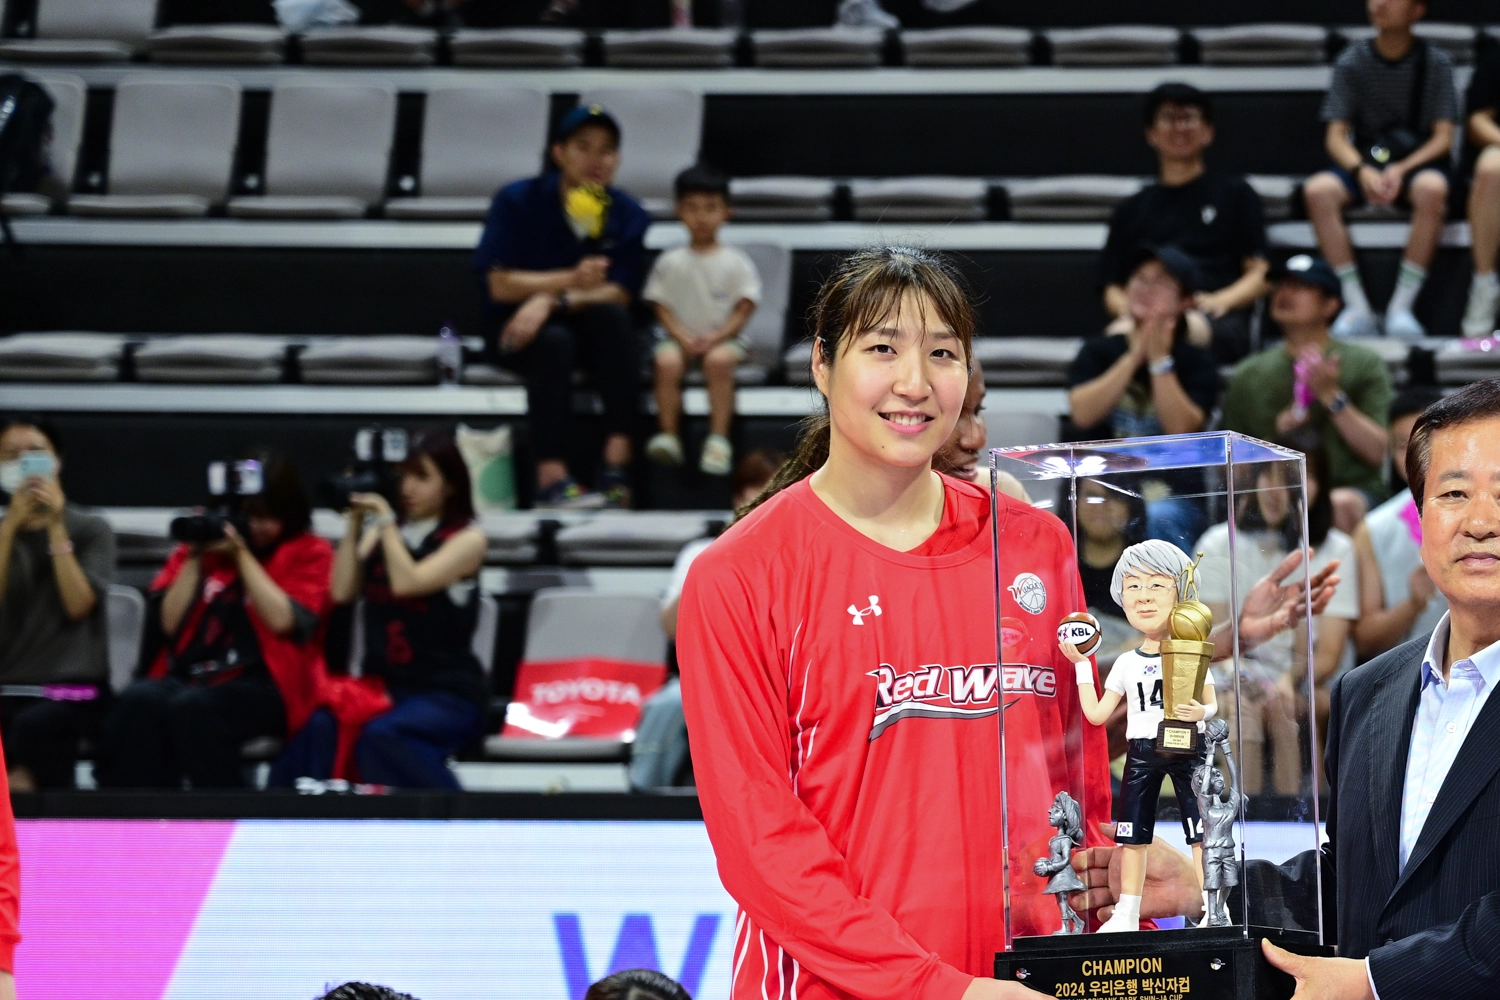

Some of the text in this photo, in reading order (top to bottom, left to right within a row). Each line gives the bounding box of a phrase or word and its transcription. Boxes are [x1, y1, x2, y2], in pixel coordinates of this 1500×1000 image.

[532, 678, 641, 704] TOYOTA
[868, 664, 1057, 710] Red Wave
[1082, 958, 1162, 976] CHAMPION
[1055, 976, 1190, 997] 2024 우리은행 박신자컵
